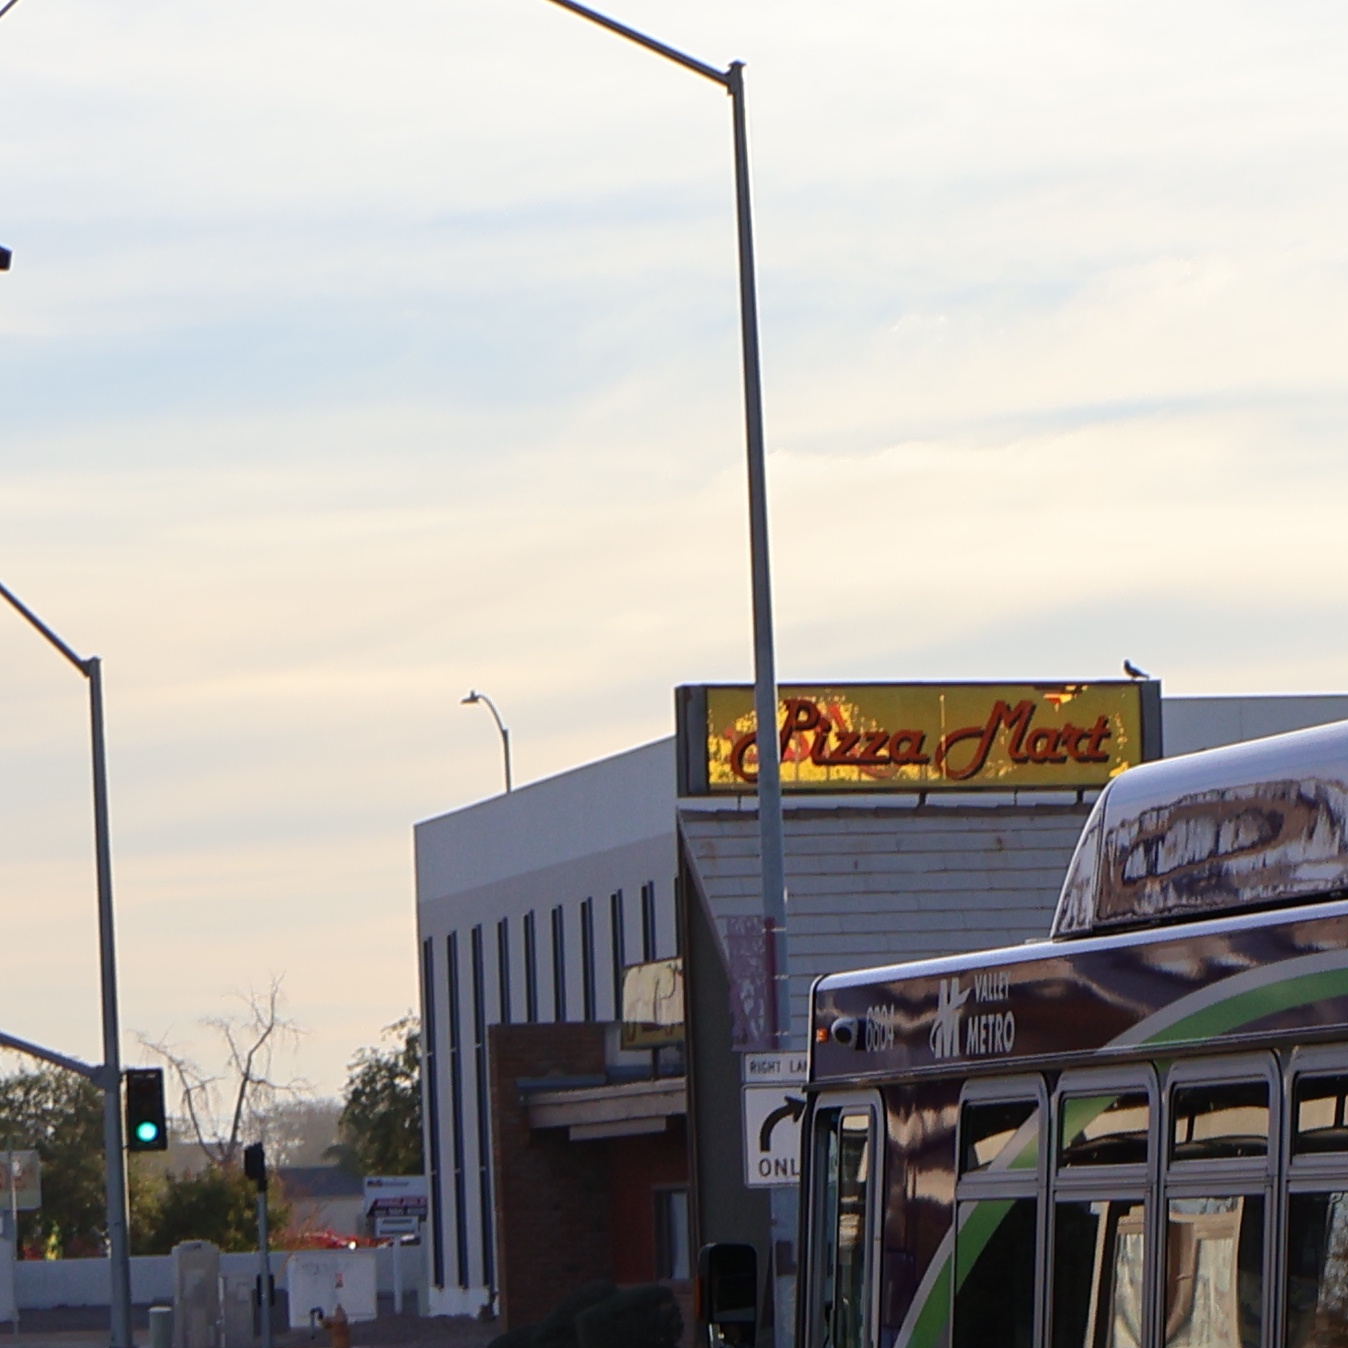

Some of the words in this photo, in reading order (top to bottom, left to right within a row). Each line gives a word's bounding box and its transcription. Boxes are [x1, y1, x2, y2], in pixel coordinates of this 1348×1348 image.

[730, 698, 931, 780] Pizza
[935, 700, 1113, 780] Mart
[973, 971, 1011, 1003] VALLEY
[865, 1004, 896, 1054] 6804
[965, 1010, 1016, 1056] METRO
[749, 1059, 782, 1074] RIGHT
